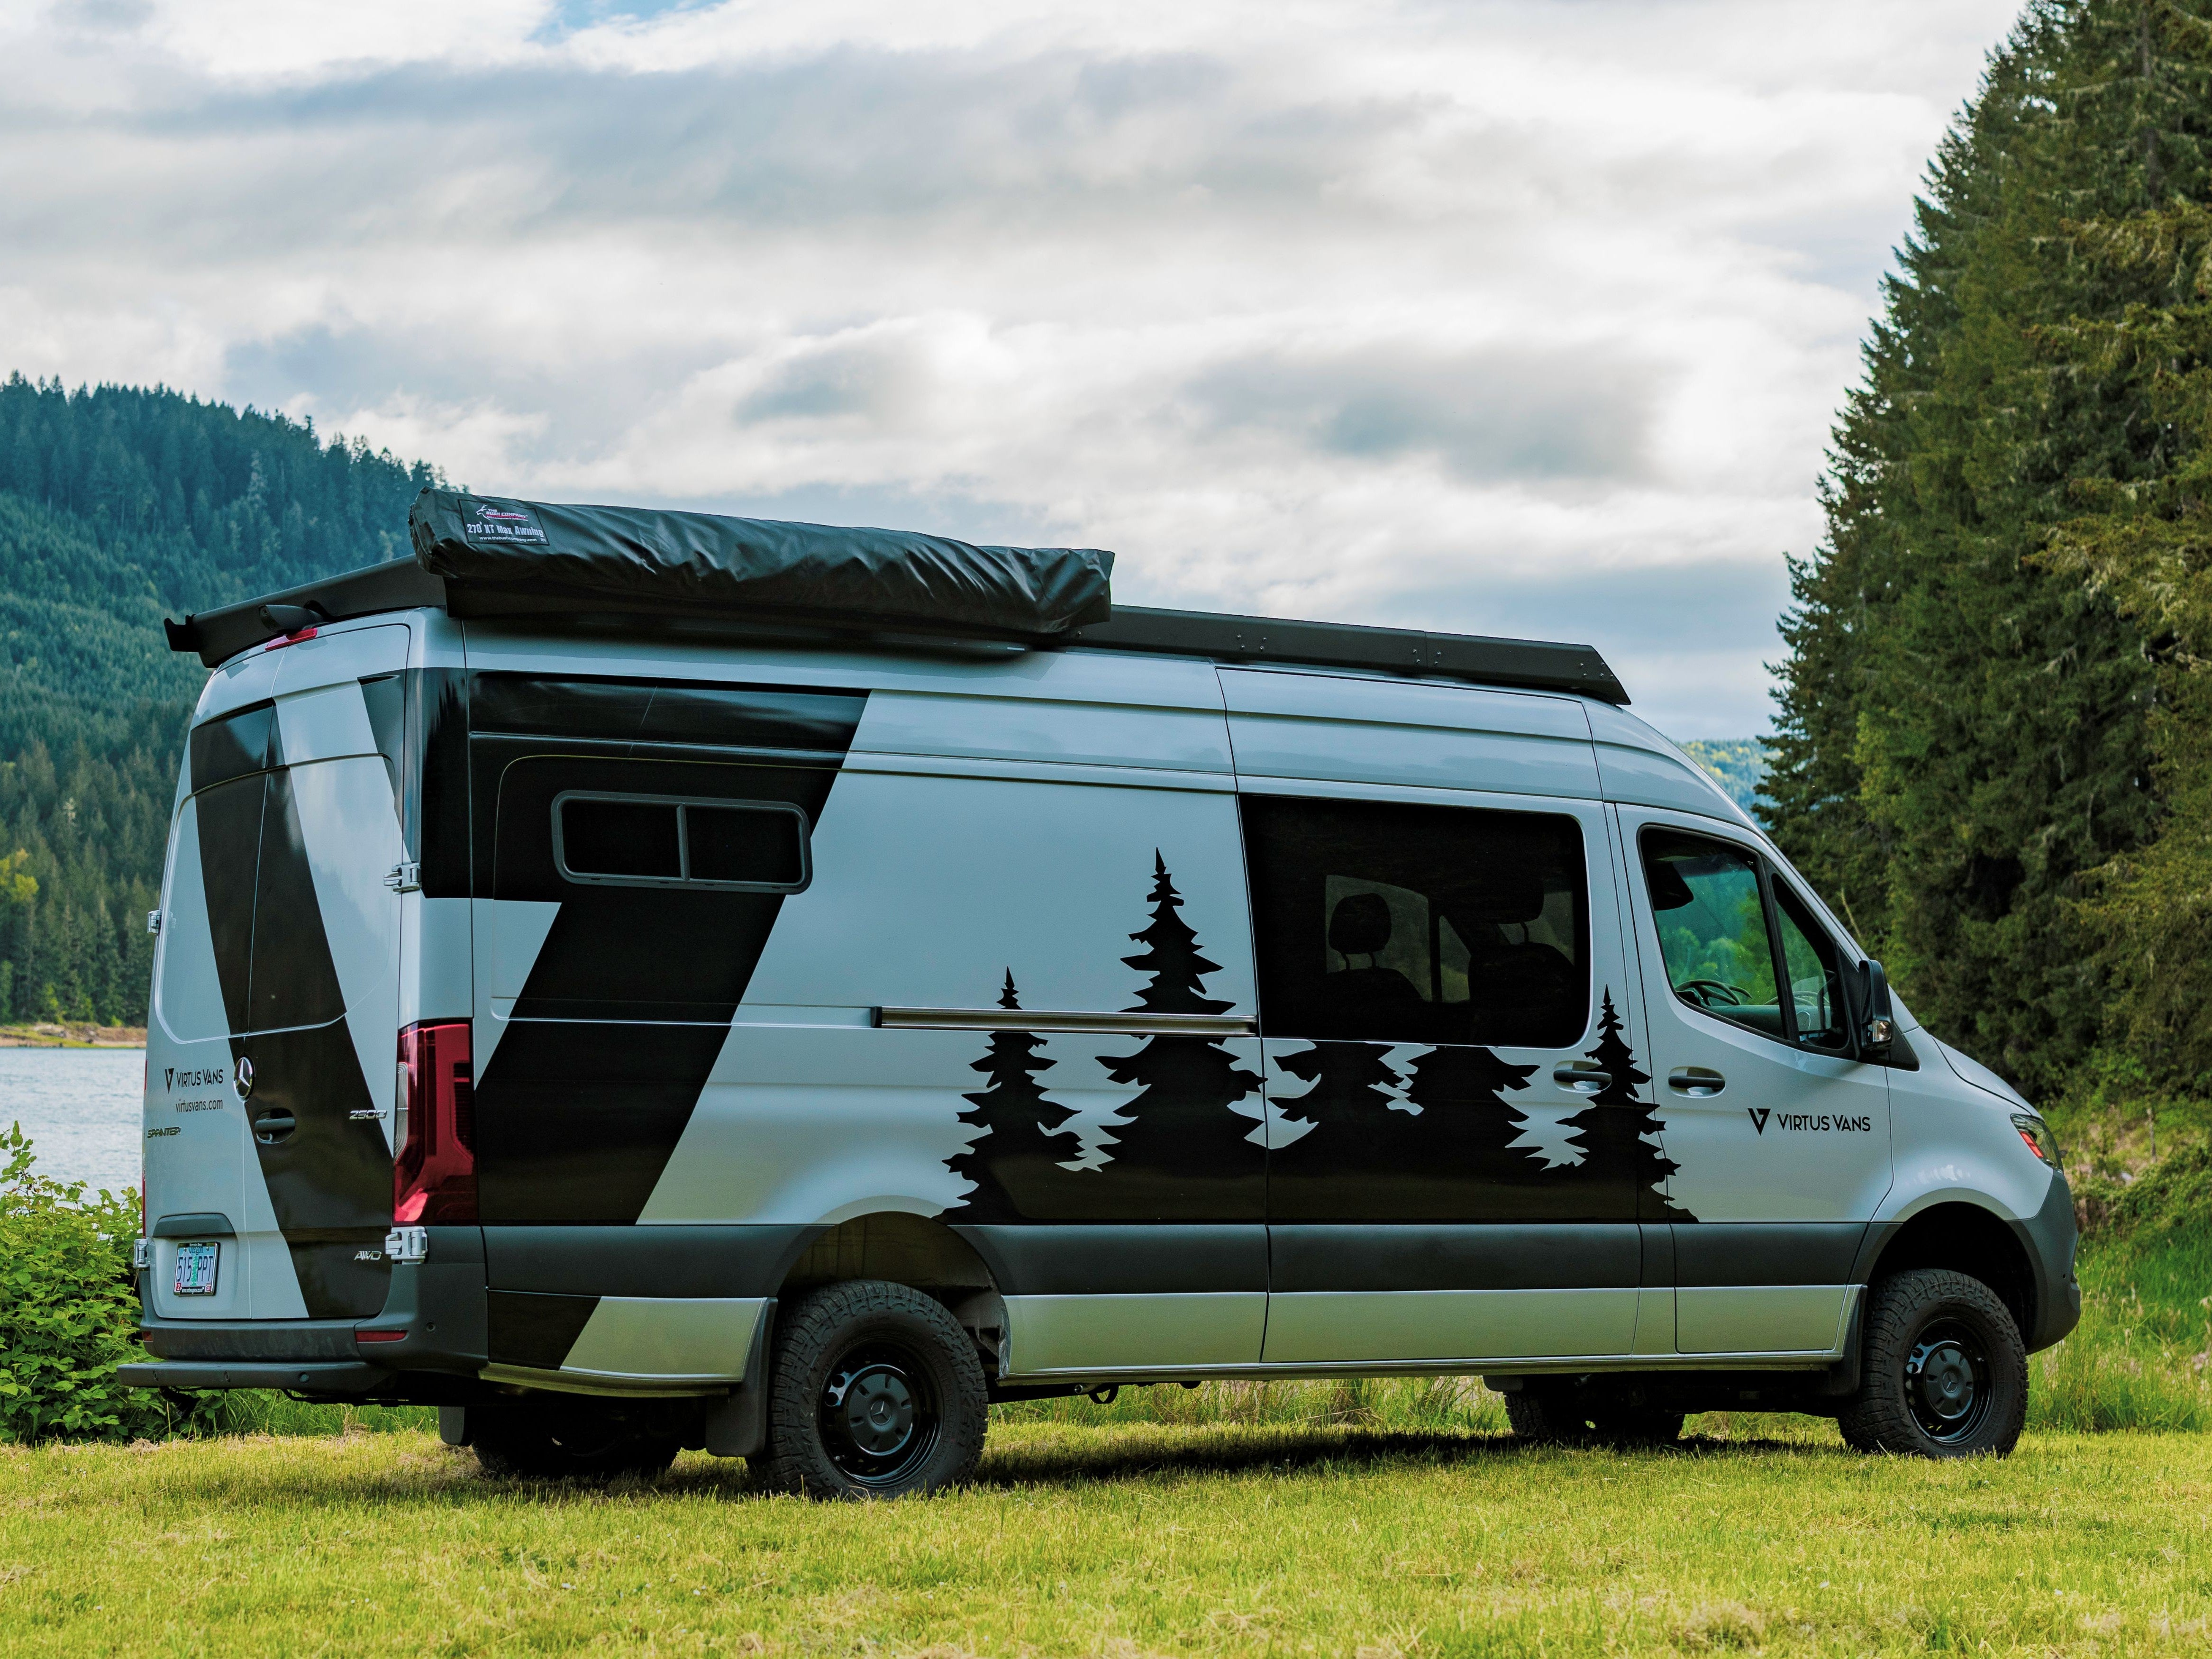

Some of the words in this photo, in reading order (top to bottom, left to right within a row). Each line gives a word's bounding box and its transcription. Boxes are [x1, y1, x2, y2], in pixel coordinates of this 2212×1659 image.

[483, 524, 494, 534] XT
[496, 525, 513, 535] Max
[514, 525, 544, 538] Awning
[176, 1071, 201, 1088] VIRTUS
[202, 1068, 223, 1085] VANS
[175, 1098, 223, 1113] virtusvans.com
[349, 1110, 388, 1120] 2500
[1776, 1113, 1830, 1131] VIRTUS
[1832, 1114, 1871, 1132] VANS
[147, 1126, 181, 1138] SPRINTER
[354, 1250, 382, 1260] AWD
[177, 1257, 192, 1282] 515
[197, 1256, 213, 1282] PPT
